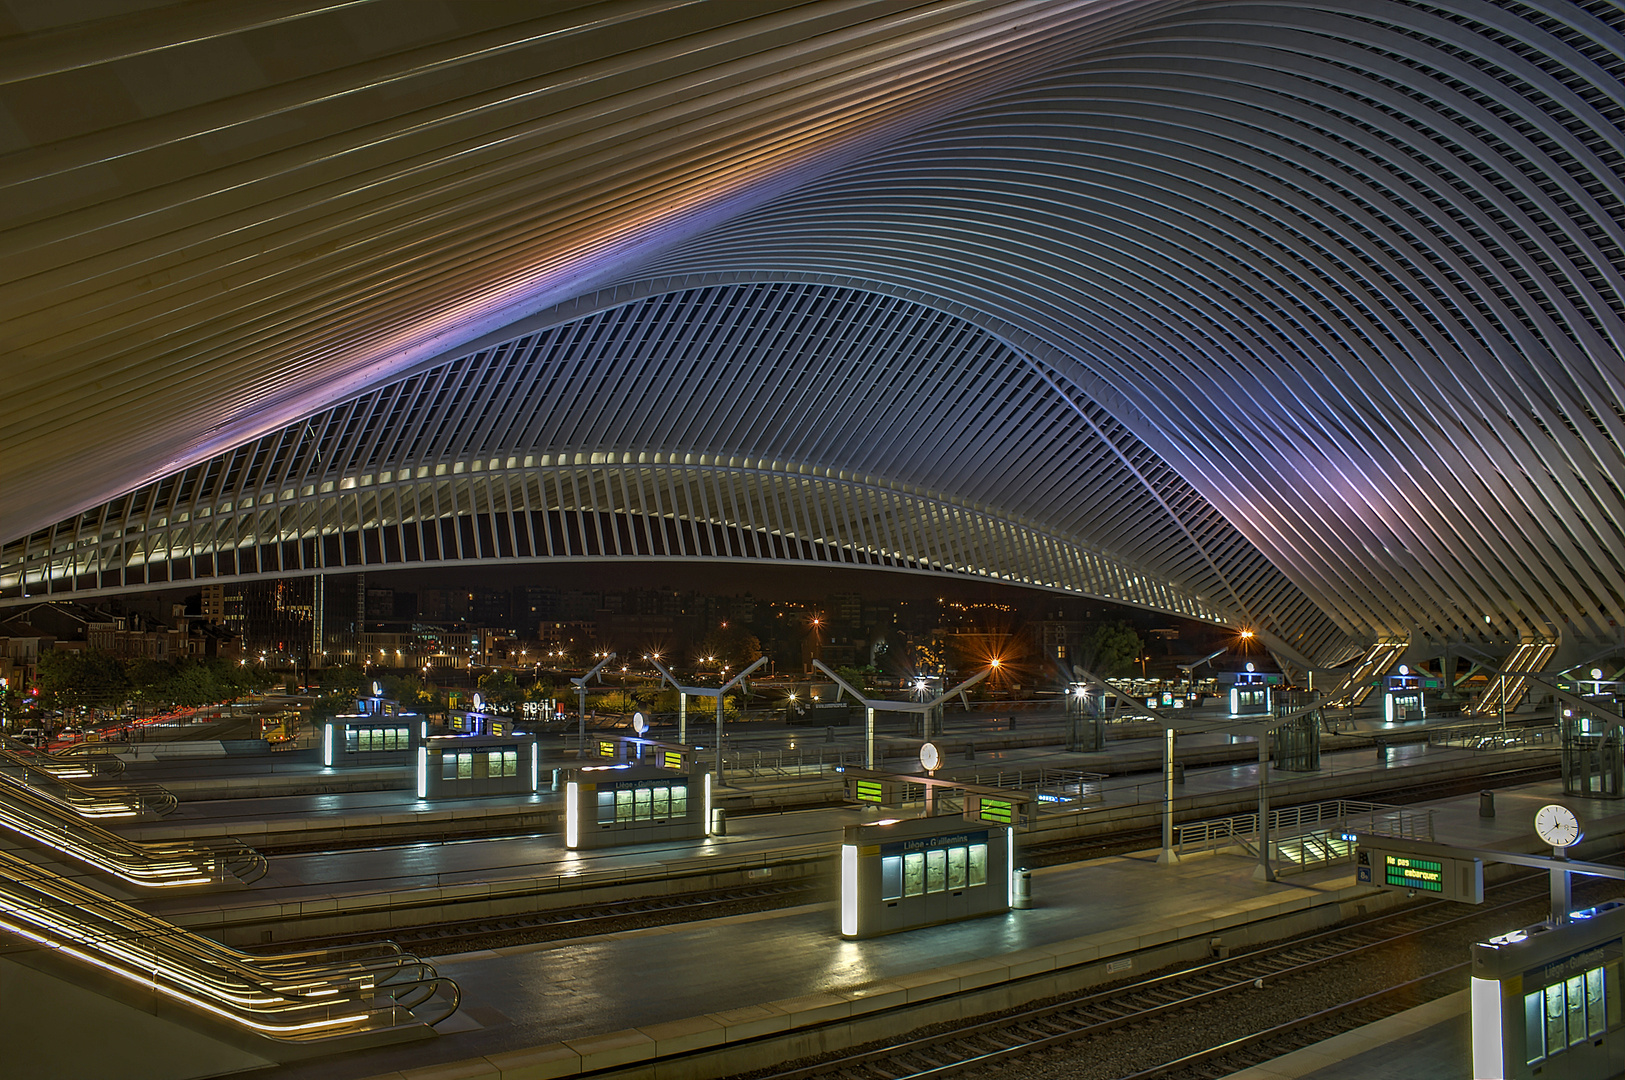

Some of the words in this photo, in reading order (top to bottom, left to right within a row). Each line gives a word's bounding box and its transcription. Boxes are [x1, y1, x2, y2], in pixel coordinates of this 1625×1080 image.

[638, 779, 671, 787] Guillemins
[903, 840, 924, 851] Liège
[930, 835, 968, 845] Guillemins
[1387, 855, 1396, 865] Ne
[1397, 858, 1410, 867] pas
[1545, 963, 1565, 979] Liège
